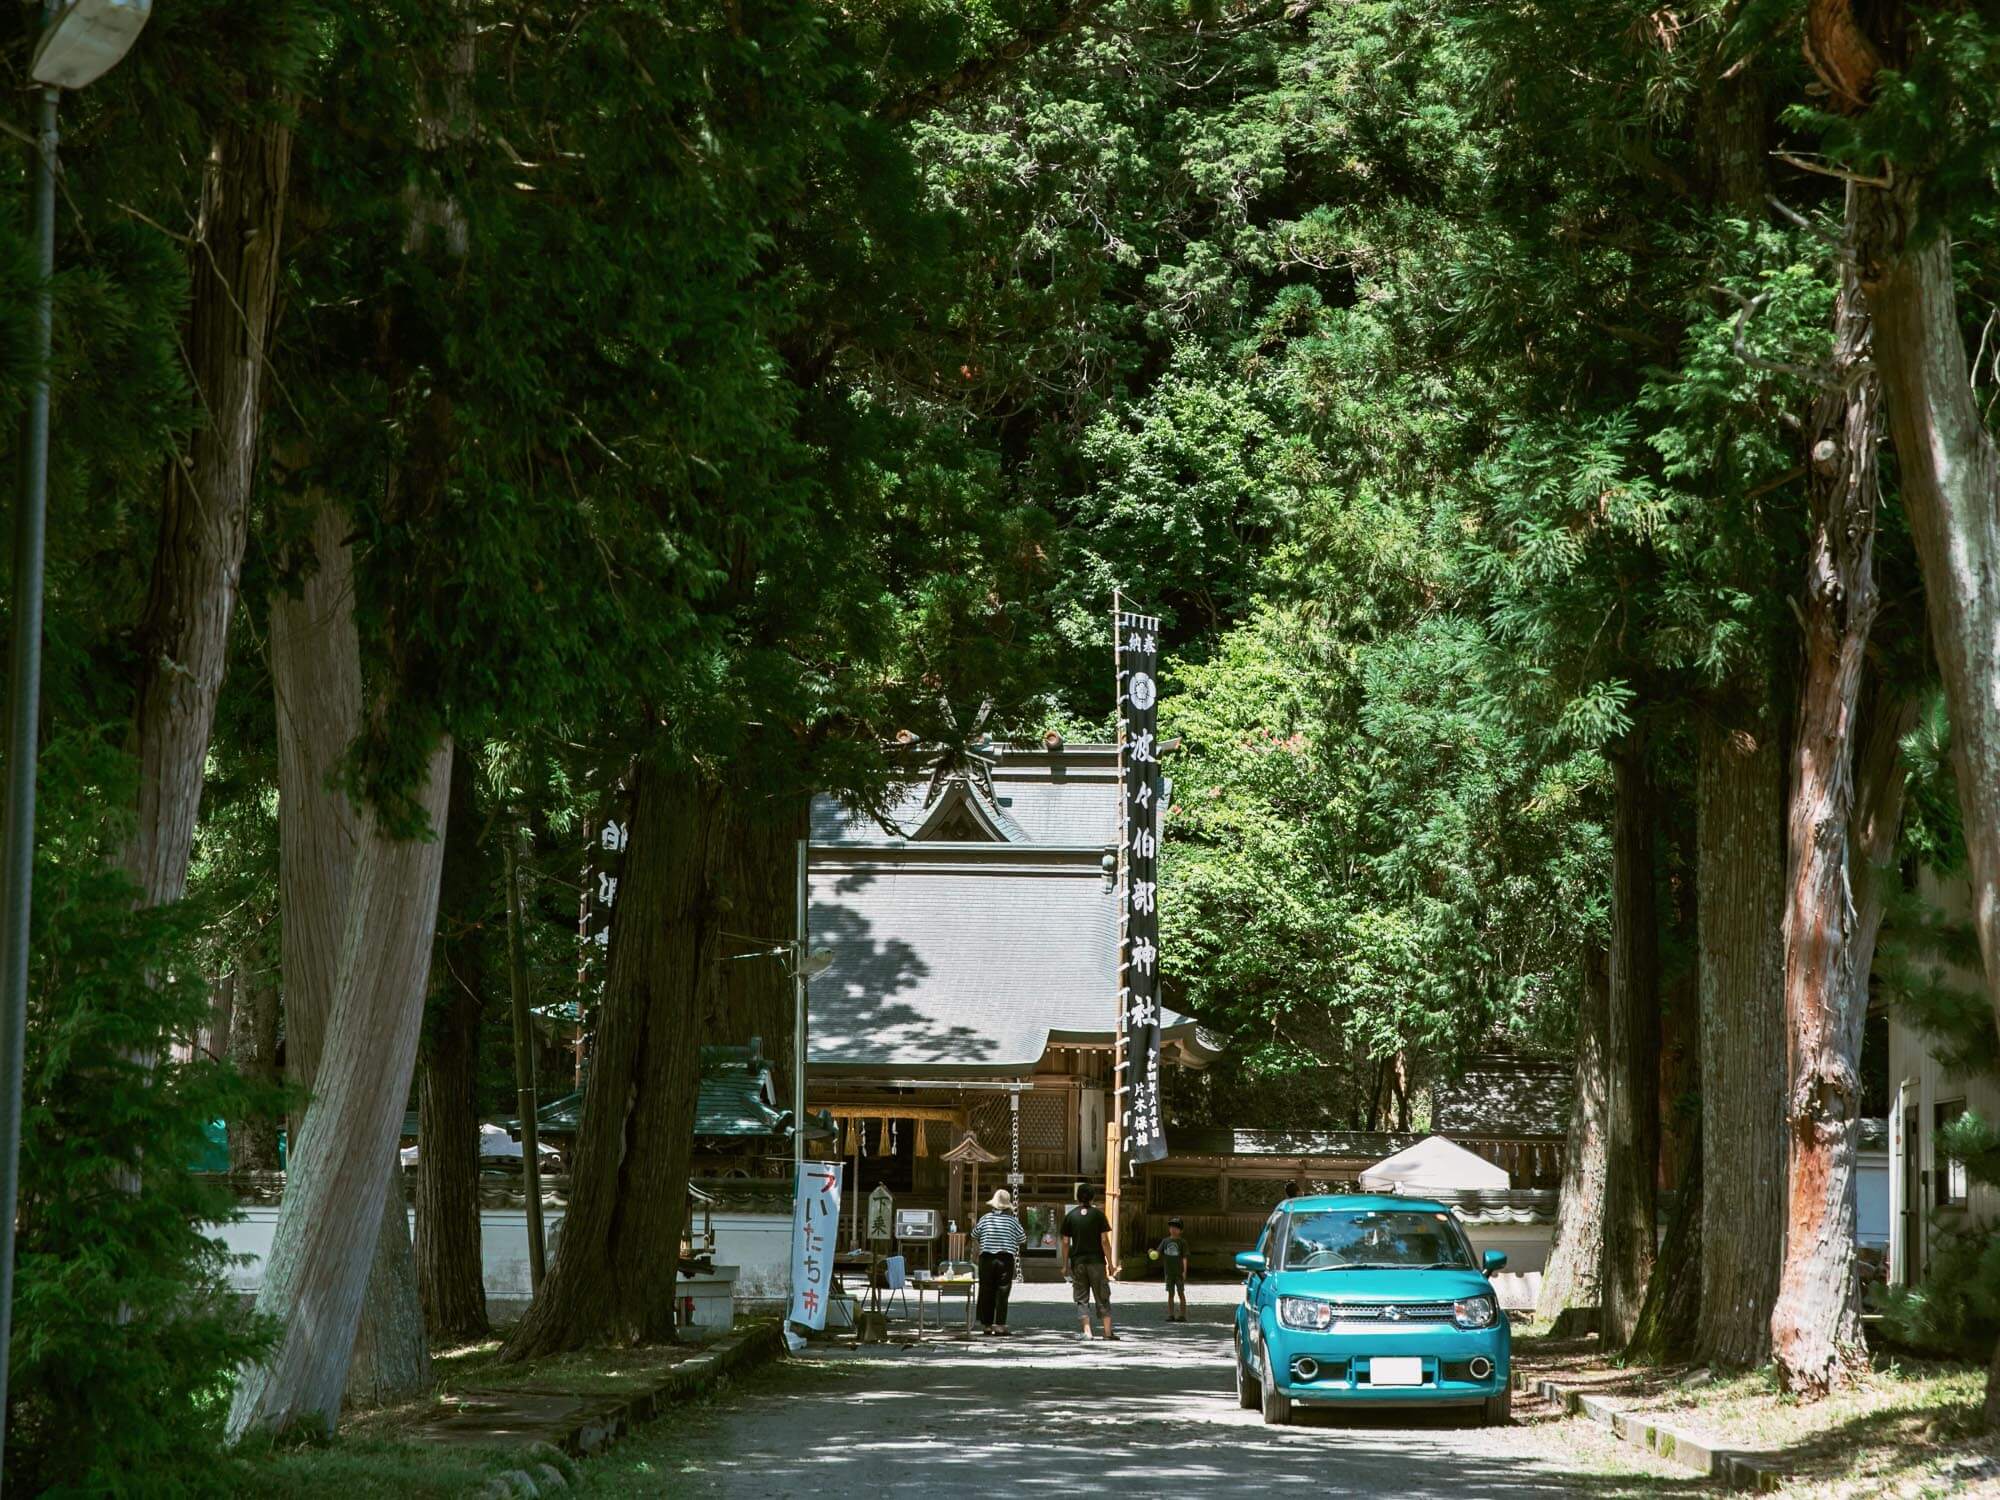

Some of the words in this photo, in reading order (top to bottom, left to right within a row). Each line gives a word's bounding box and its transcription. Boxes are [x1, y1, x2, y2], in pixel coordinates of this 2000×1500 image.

[1128, 632, 1157, 656] 奉納
[1130, 728, 1159, 1028] 波々伯部神社
